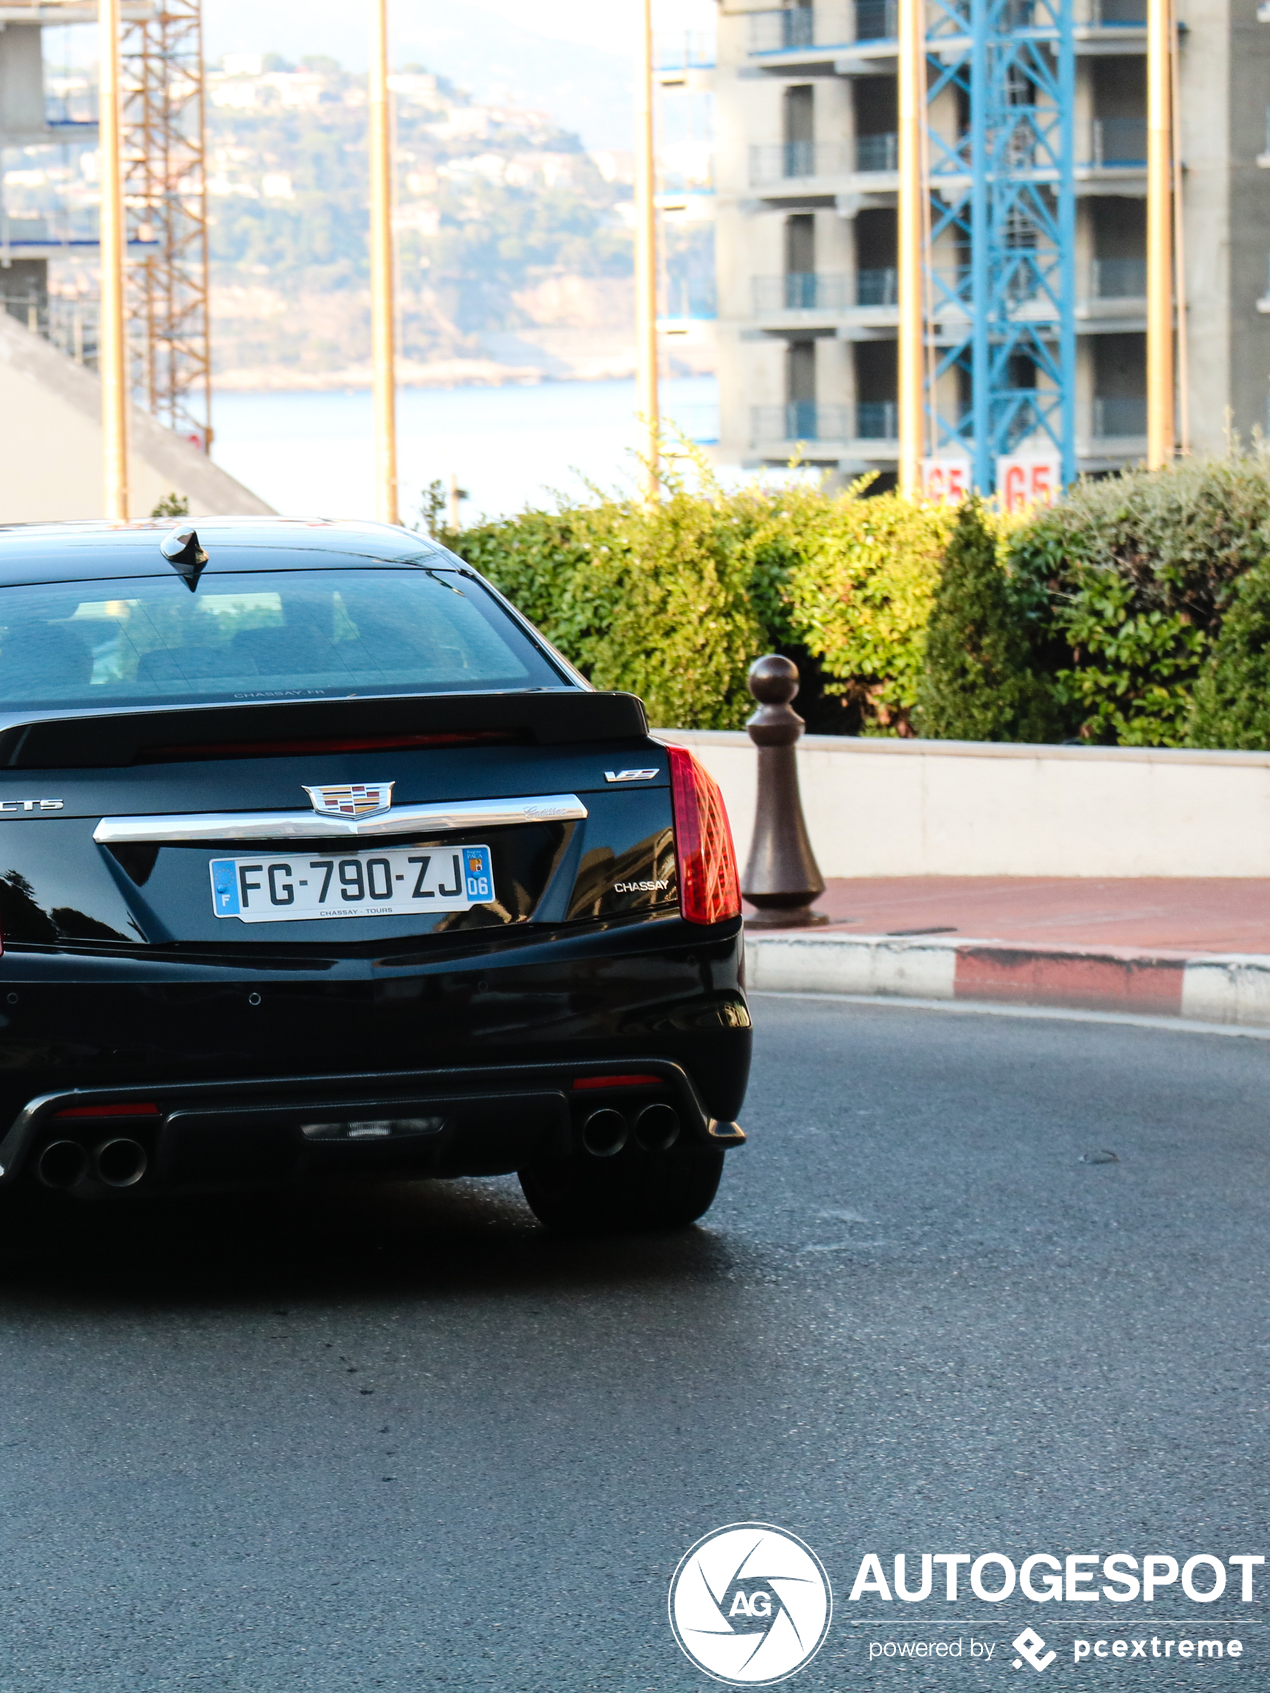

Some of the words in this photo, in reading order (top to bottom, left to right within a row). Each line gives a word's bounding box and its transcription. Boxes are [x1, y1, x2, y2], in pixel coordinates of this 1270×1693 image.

[1005, 466, 1053, 516] G5
[233, 689, 326, 699] CHASSAY.FR
[522, 805, 567, 821] Cadillac
[238, 854, 463, 908] FG-790-ZJ
[467, 877, 489, 896] 06
[614, 879, 670, 893] CHASSAY
[221, 894, 231, 907] F
[319, 909, 358, 917] CHASSAY
